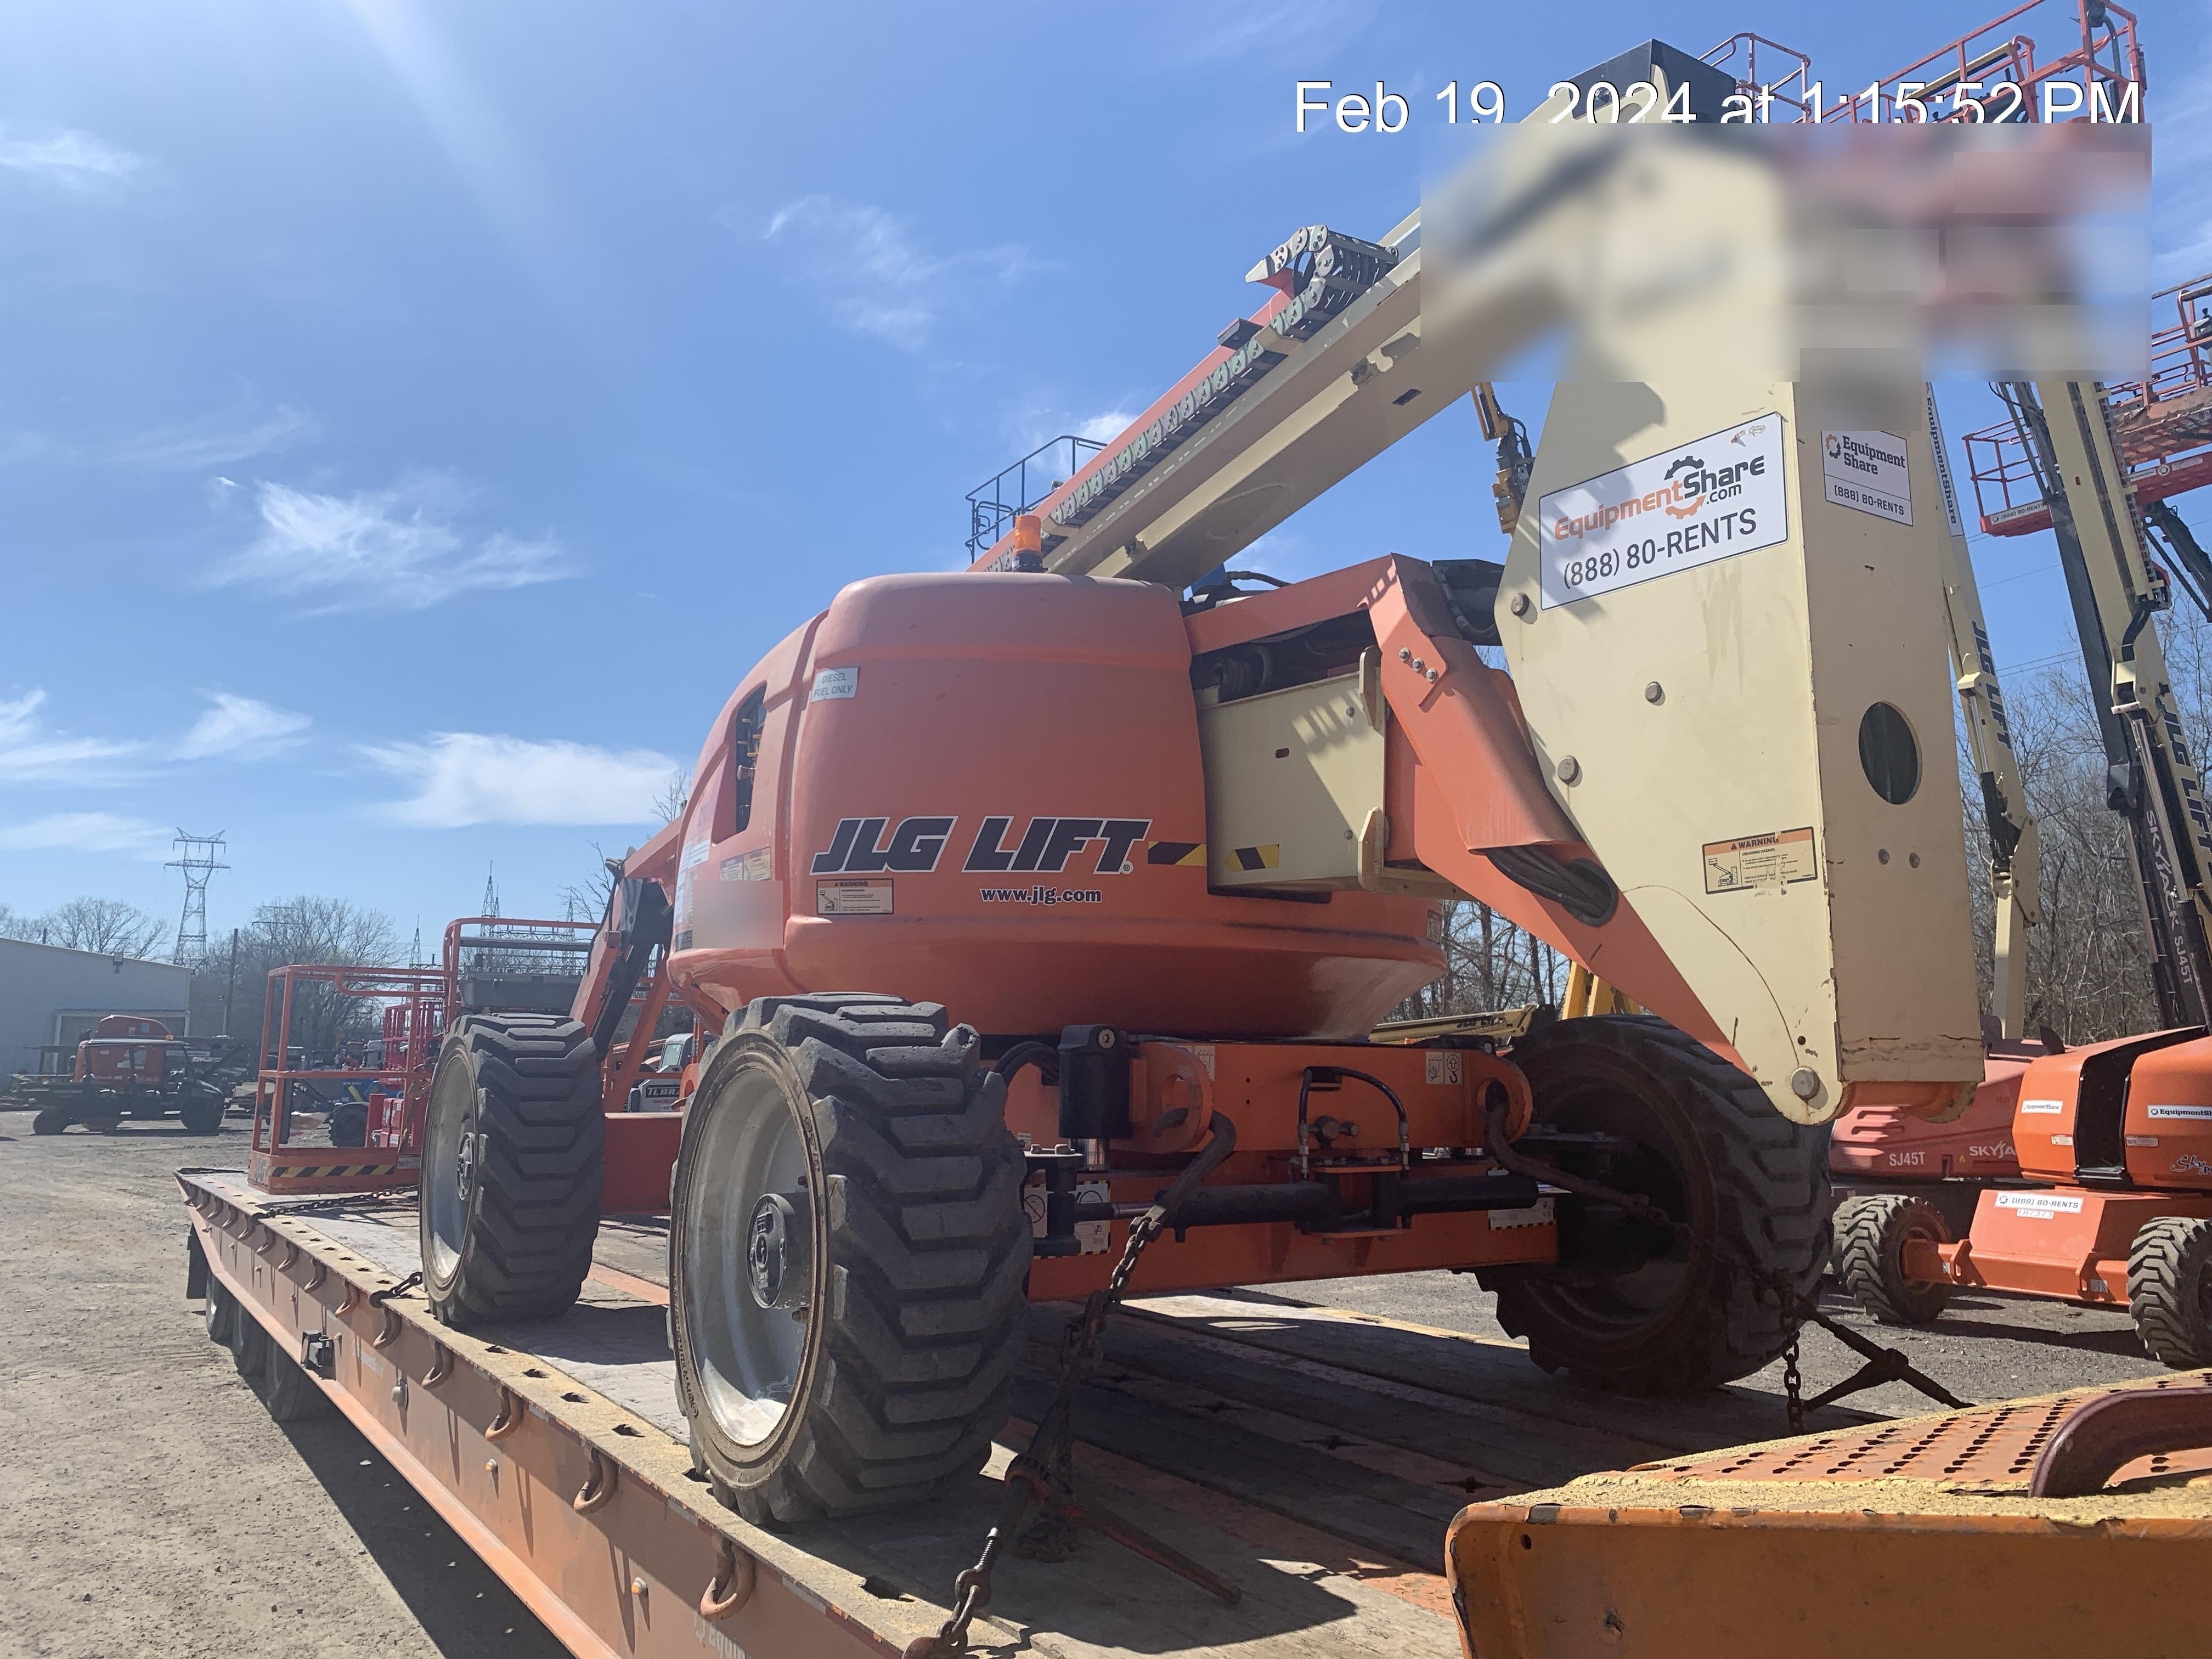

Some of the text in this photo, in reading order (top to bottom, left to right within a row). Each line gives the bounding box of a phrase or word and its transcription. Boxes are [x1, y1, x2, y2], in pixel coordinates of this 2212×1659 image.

[1842, 435, 1906, 469] Equipment
[1844, 452, 1878, 475] Share
[1554, 455, 1765, 540] EquipmentShare
[1706, 483, 1742, 505] .com
[1834, 484, 1904, 516] (888) 80-RENTS
[1564, 508, 1757, 590] (888) 80-RENTS
[822, 673, 847, 684] DIESEL
[1972, 620, 2012, 749] JLG LIFT
[813, 685, 853, 698] FUEL ONLY
[810, 815, 1153, 874] JLG LIFT
[1738, 837, 1779, 849] WARNING
[980, 885, 1102, 905] www.jlg.com
[2174, 935, 2194, 984] SJ45T
[1889, 1152, 1926, 1166] SJ45T
[2011, 1197, 2079, 1209] (888) 80-RENTS
